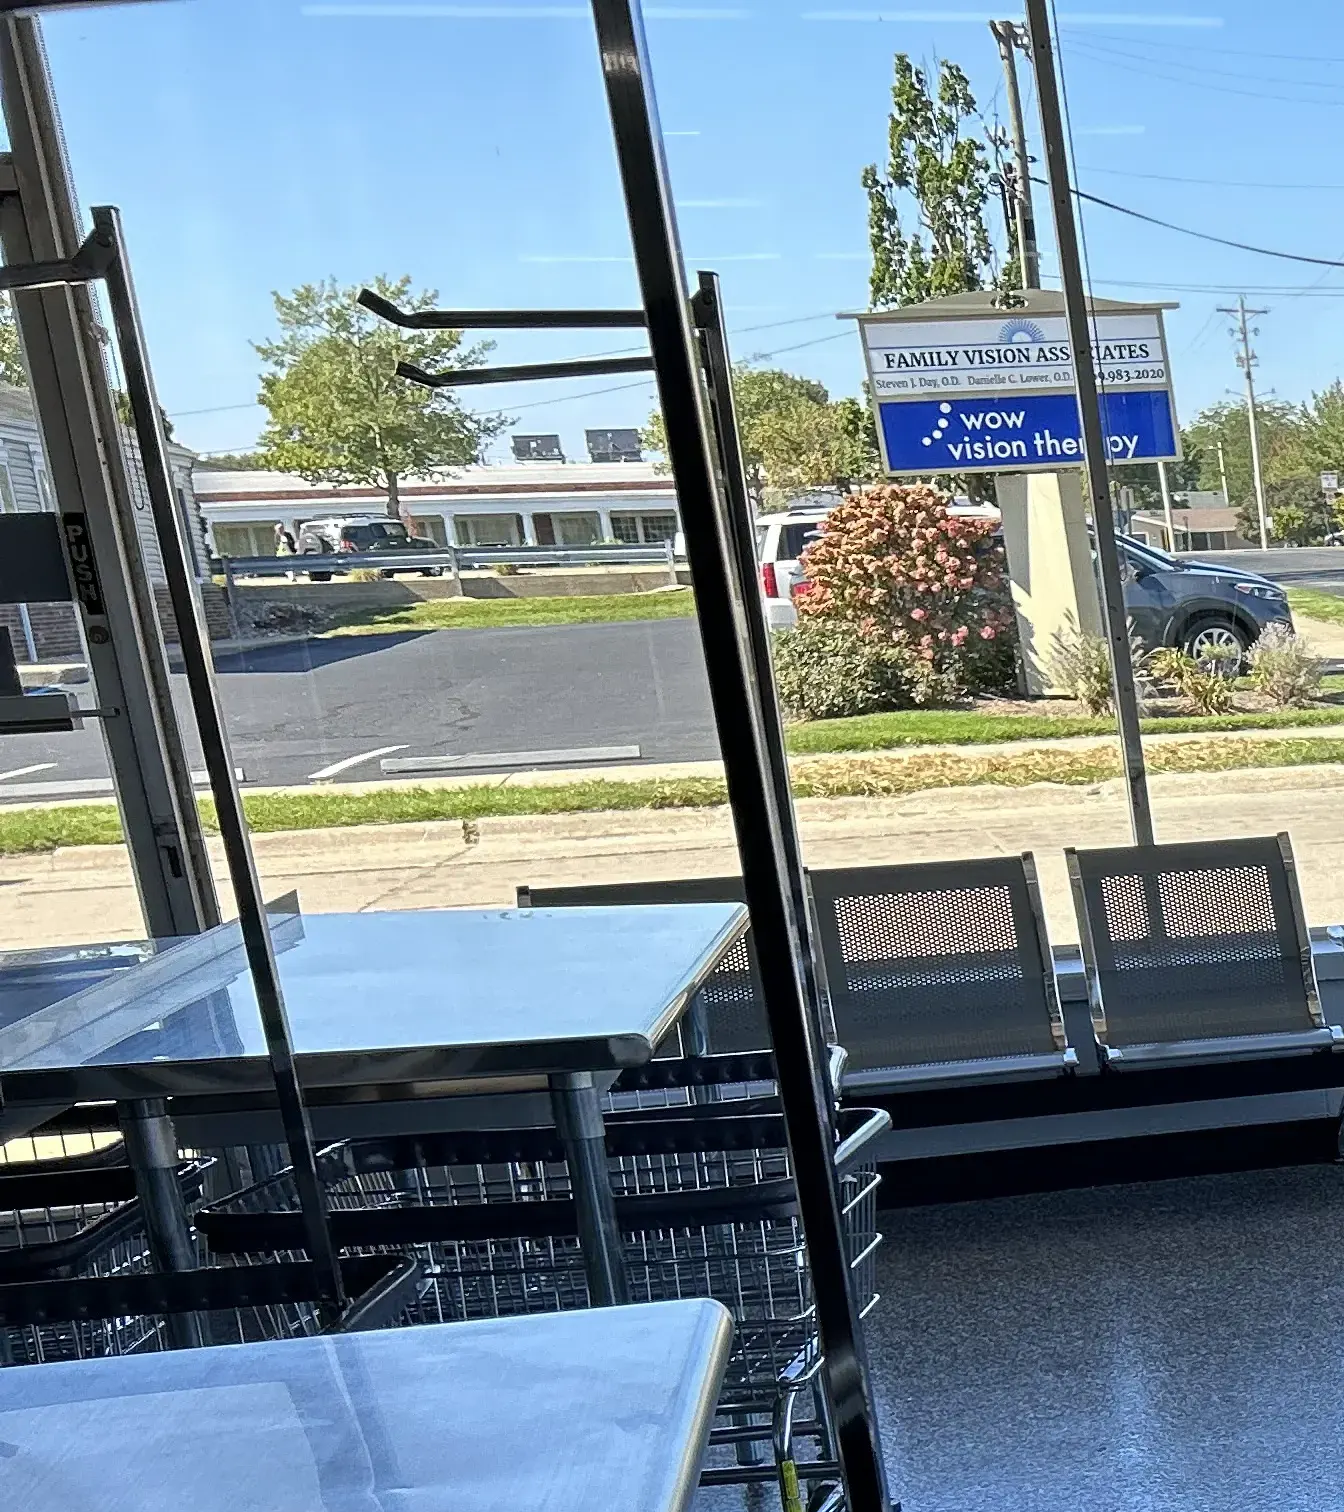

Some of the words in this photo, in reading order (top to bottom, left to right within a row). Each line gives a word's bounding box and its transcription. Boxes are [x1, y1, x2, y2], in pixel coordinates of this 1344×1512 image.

[884, 350, 959, 369] FAMILY
[963, 348, 1030, 366] VISION
[1036, 344, 1149, 363] ASSIATES
[876, 378, 908, 389] Steven
[942, 375, 961, 387] O.D.
[967, 374, 1006, 386] Danielle
[1053, 371, 1073, 382] O.D.
[960, 411, 1025, 431] wow
[947, 435, 1027, 461] vision
[1033, 429, 1139, 462] therpy
[66, 525, 97, 601] PUSH
